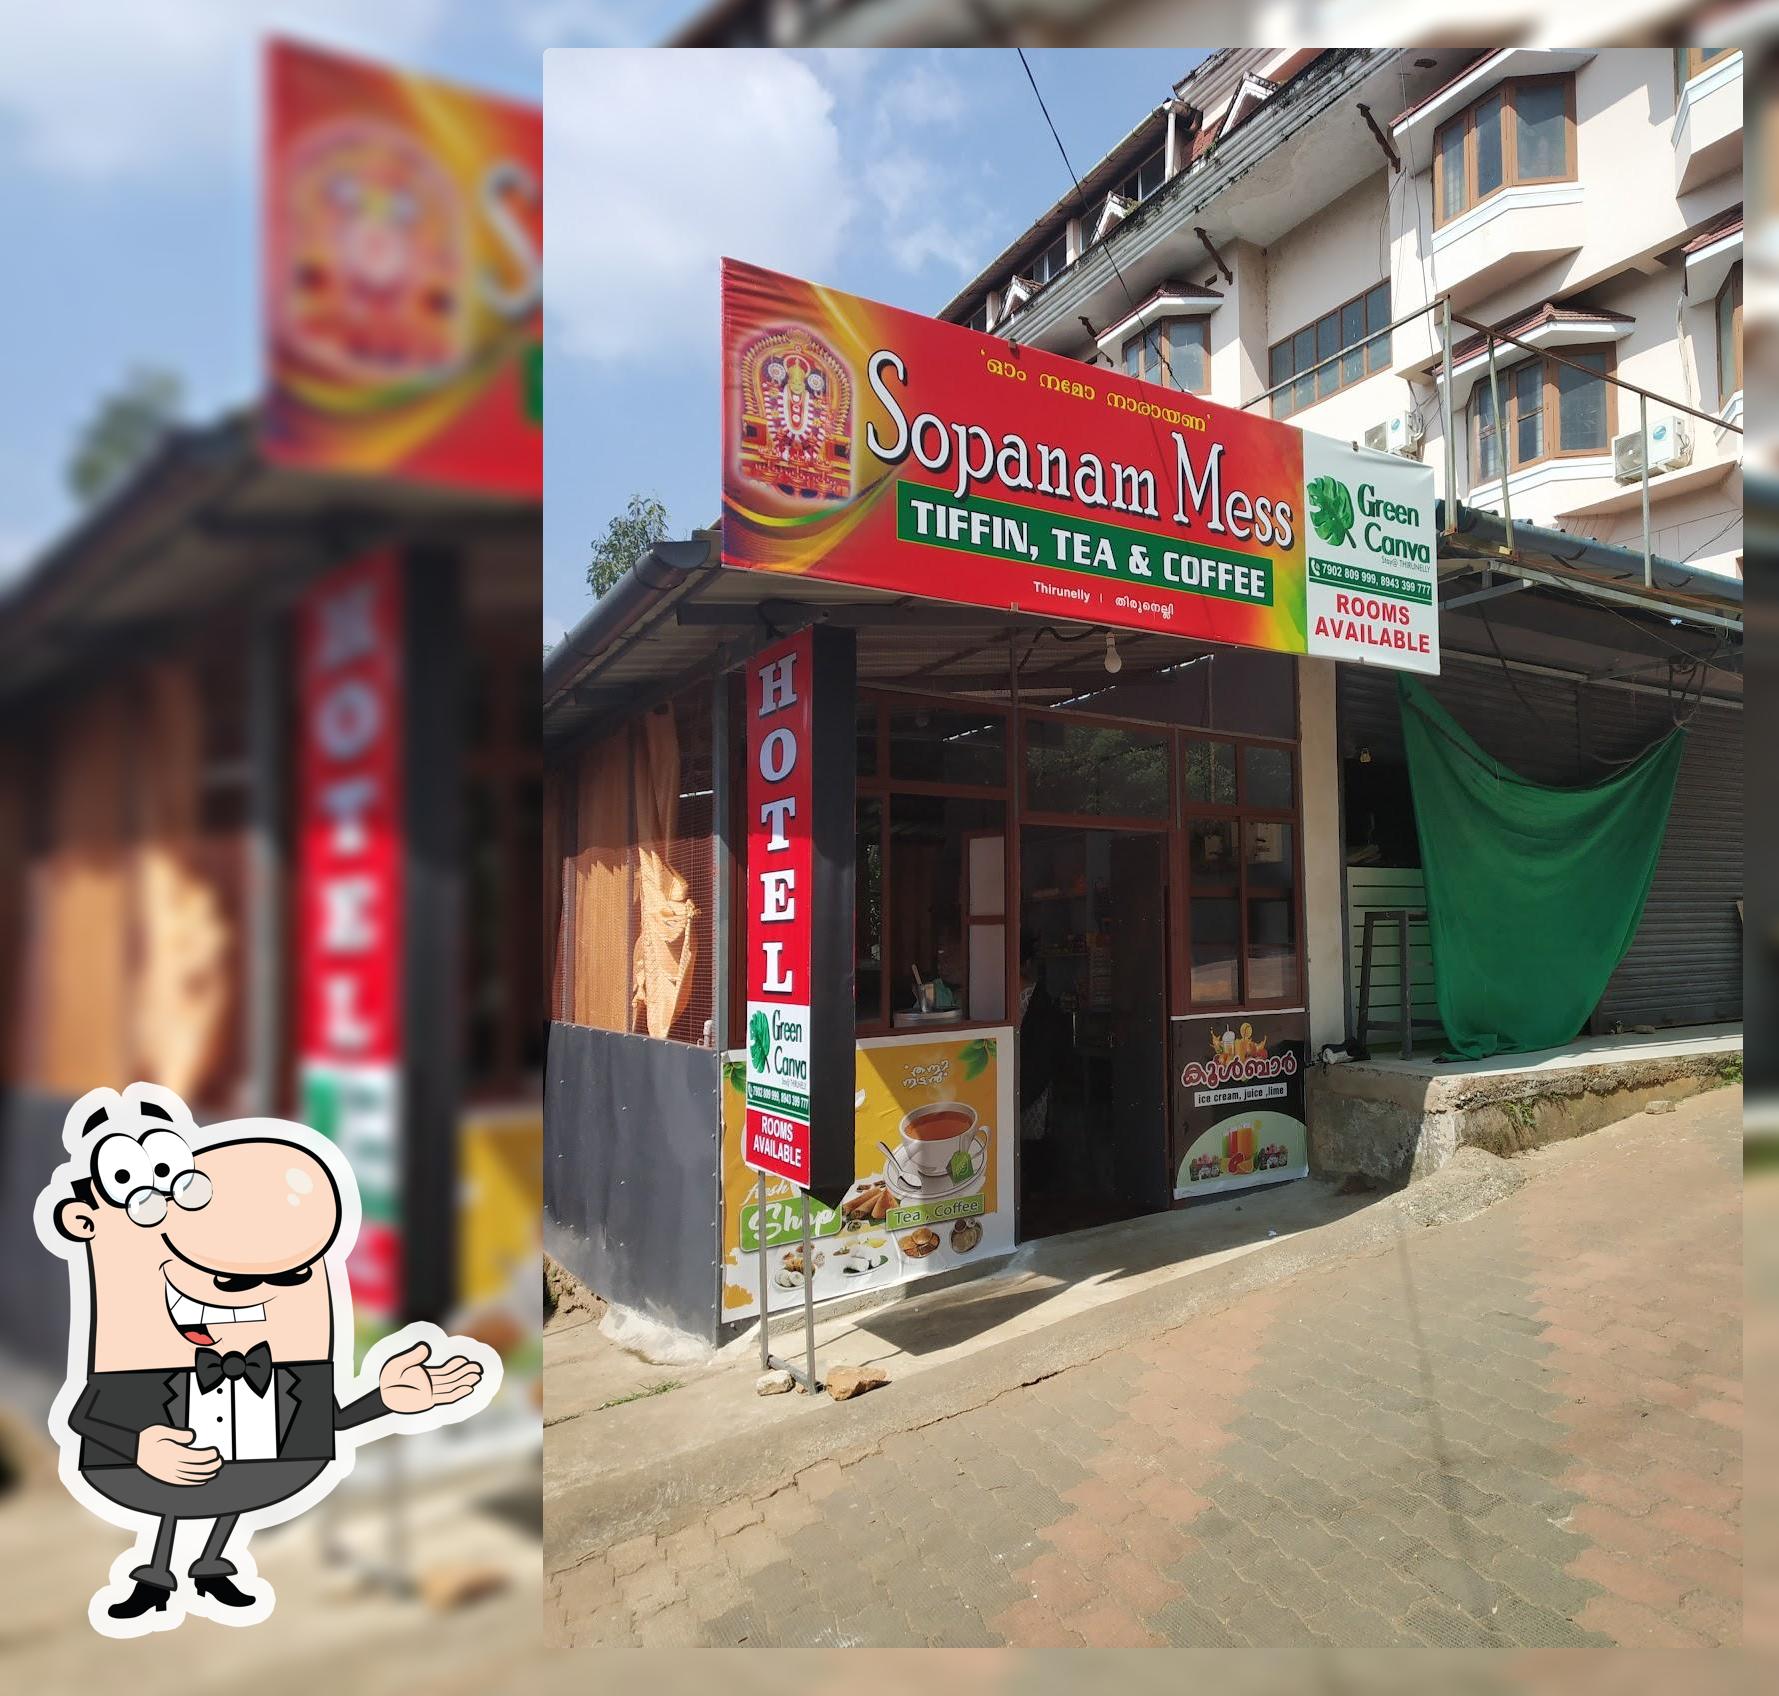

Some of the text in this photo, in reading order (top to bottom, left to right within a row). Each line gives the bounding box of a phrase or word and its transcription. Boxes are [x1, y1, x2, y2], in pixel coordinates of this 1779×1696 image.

[1039, 372, 1096, 401] നമോ
[866, 349, 1294, 550] Sopanam Mess
[1357, 483, 1420, 527] Green
[910, 498, 1266, 599] TIFFIN, TEA & COFFEE
[1364, 522, 1431, 564] Canva
[1033, 580, 1091, 604] Thirunelly
[1321, 563, 1431, 595] 7902 809 999, 8943 399 777
[1115, 595, 1175, 620] തിരുനെല്ലി
[1336, 593, 1410, 626] ROOMS
[1315, 616, 1431, 654] AVAILABLE
[758, 652, 798, 994] HOTEL
[772, 1009, 803, 1043] Green
[774, 1045, 807, 1080] Canva
[1198, 1094, 1211, 1104] ice
[1244, 1088, 1263, 1101] juice
[761, 1115, 794, 1143] ROOMS
[753, 1134, 802, 1168] AVAILABLE
[894, 1210, 921, 1225] Tea
[934, 1200, 978, 1217] Coffee
